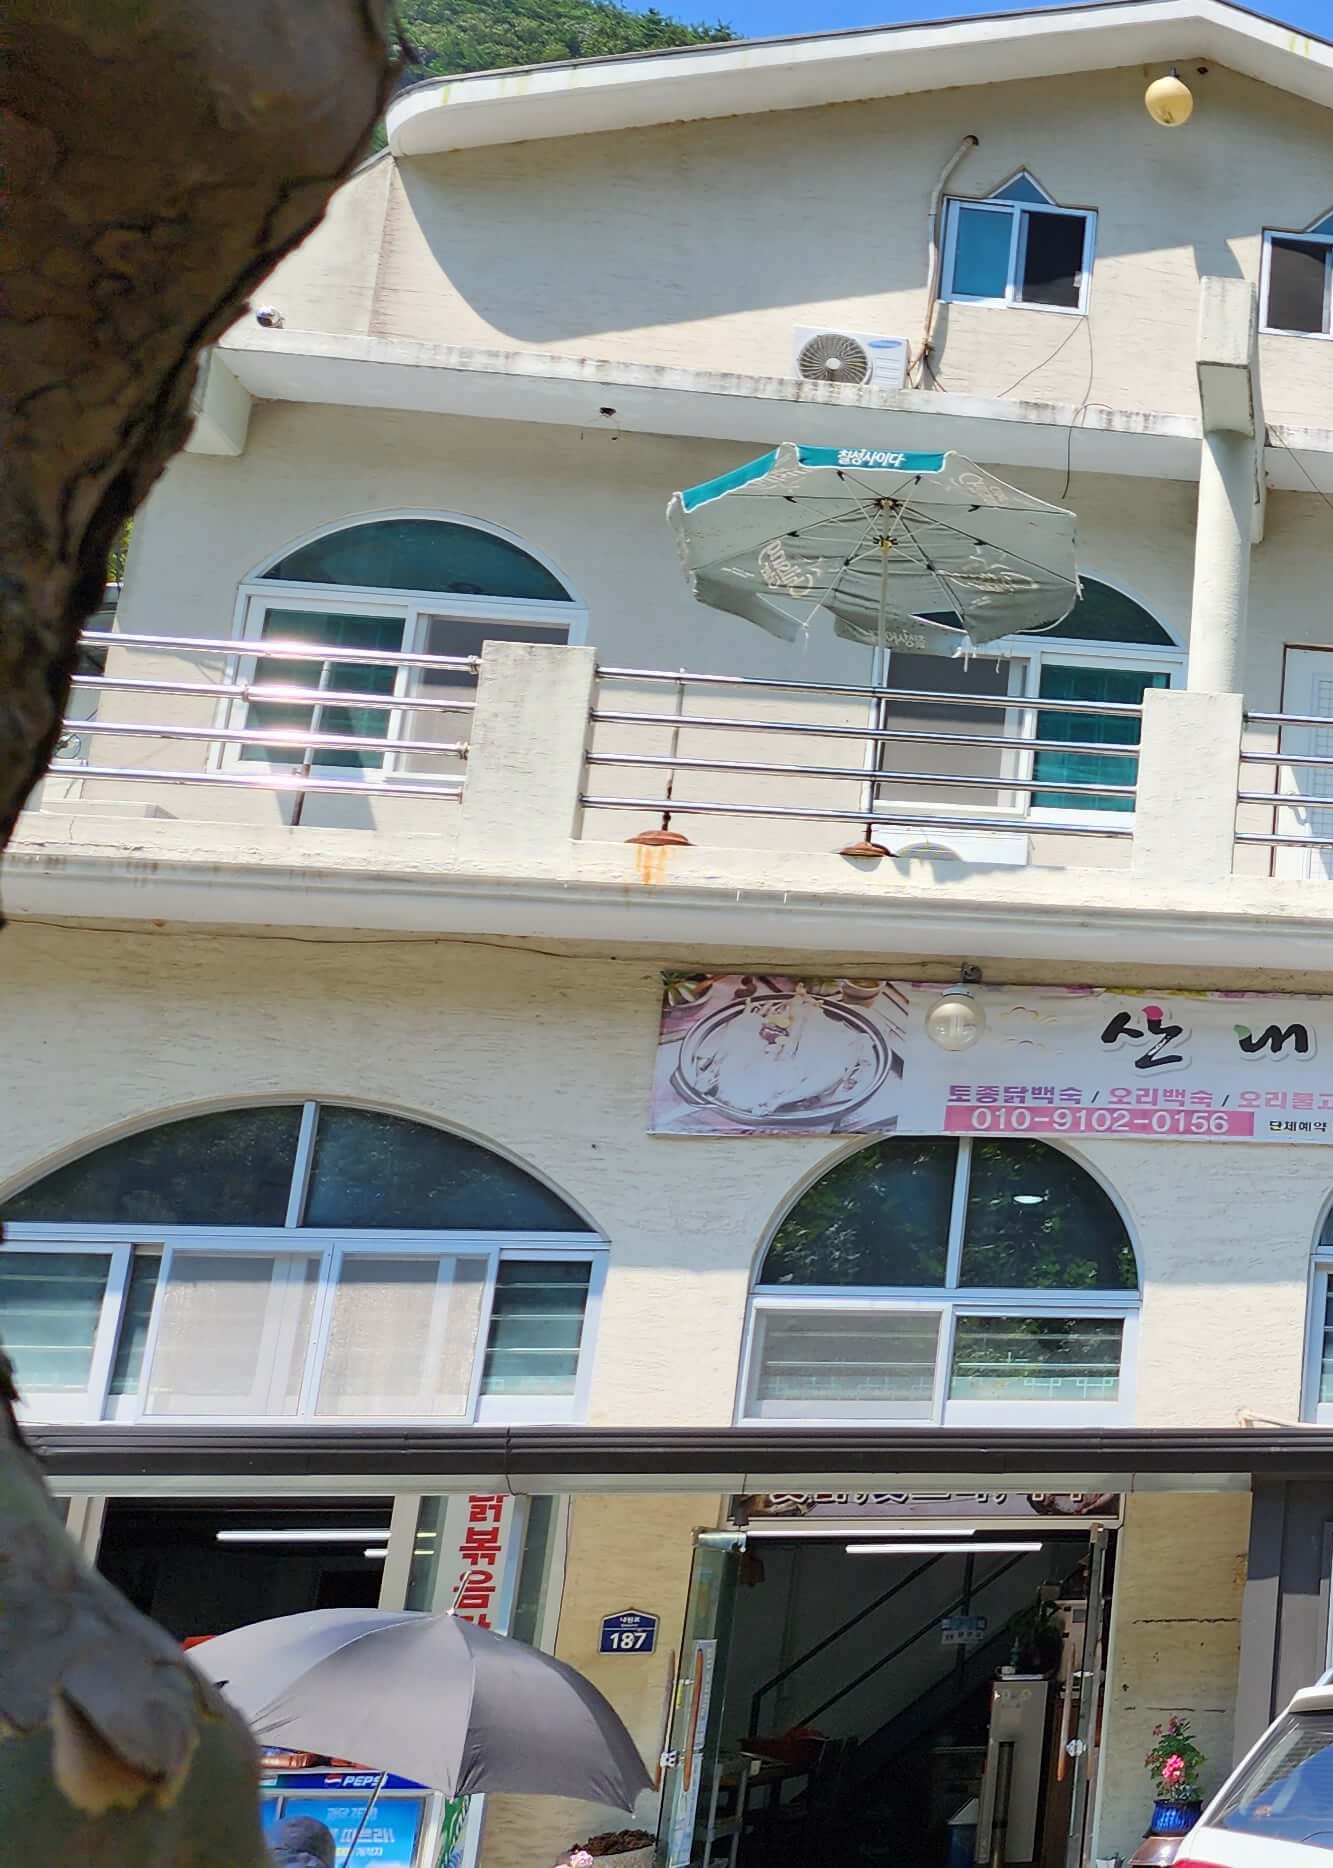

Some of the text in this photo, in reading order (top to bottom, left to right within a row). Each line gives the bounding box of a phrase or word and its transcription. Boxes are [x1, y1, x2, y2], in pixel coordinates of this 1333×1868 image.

[837, 449, 906, 467] 칠성사이다
[947, 1085, 1082, 1106] 토종닭백숙
[1108, 1087, 1214, 1108] 오리백숙
[971, 1108, 1229, 1133] 010-9102-0156
[1269, 1120, 1327, 1133] 단체예약
[453, 1494, 508, 1630] 닭볶음
[610, 1632, 648, 1649] 187
